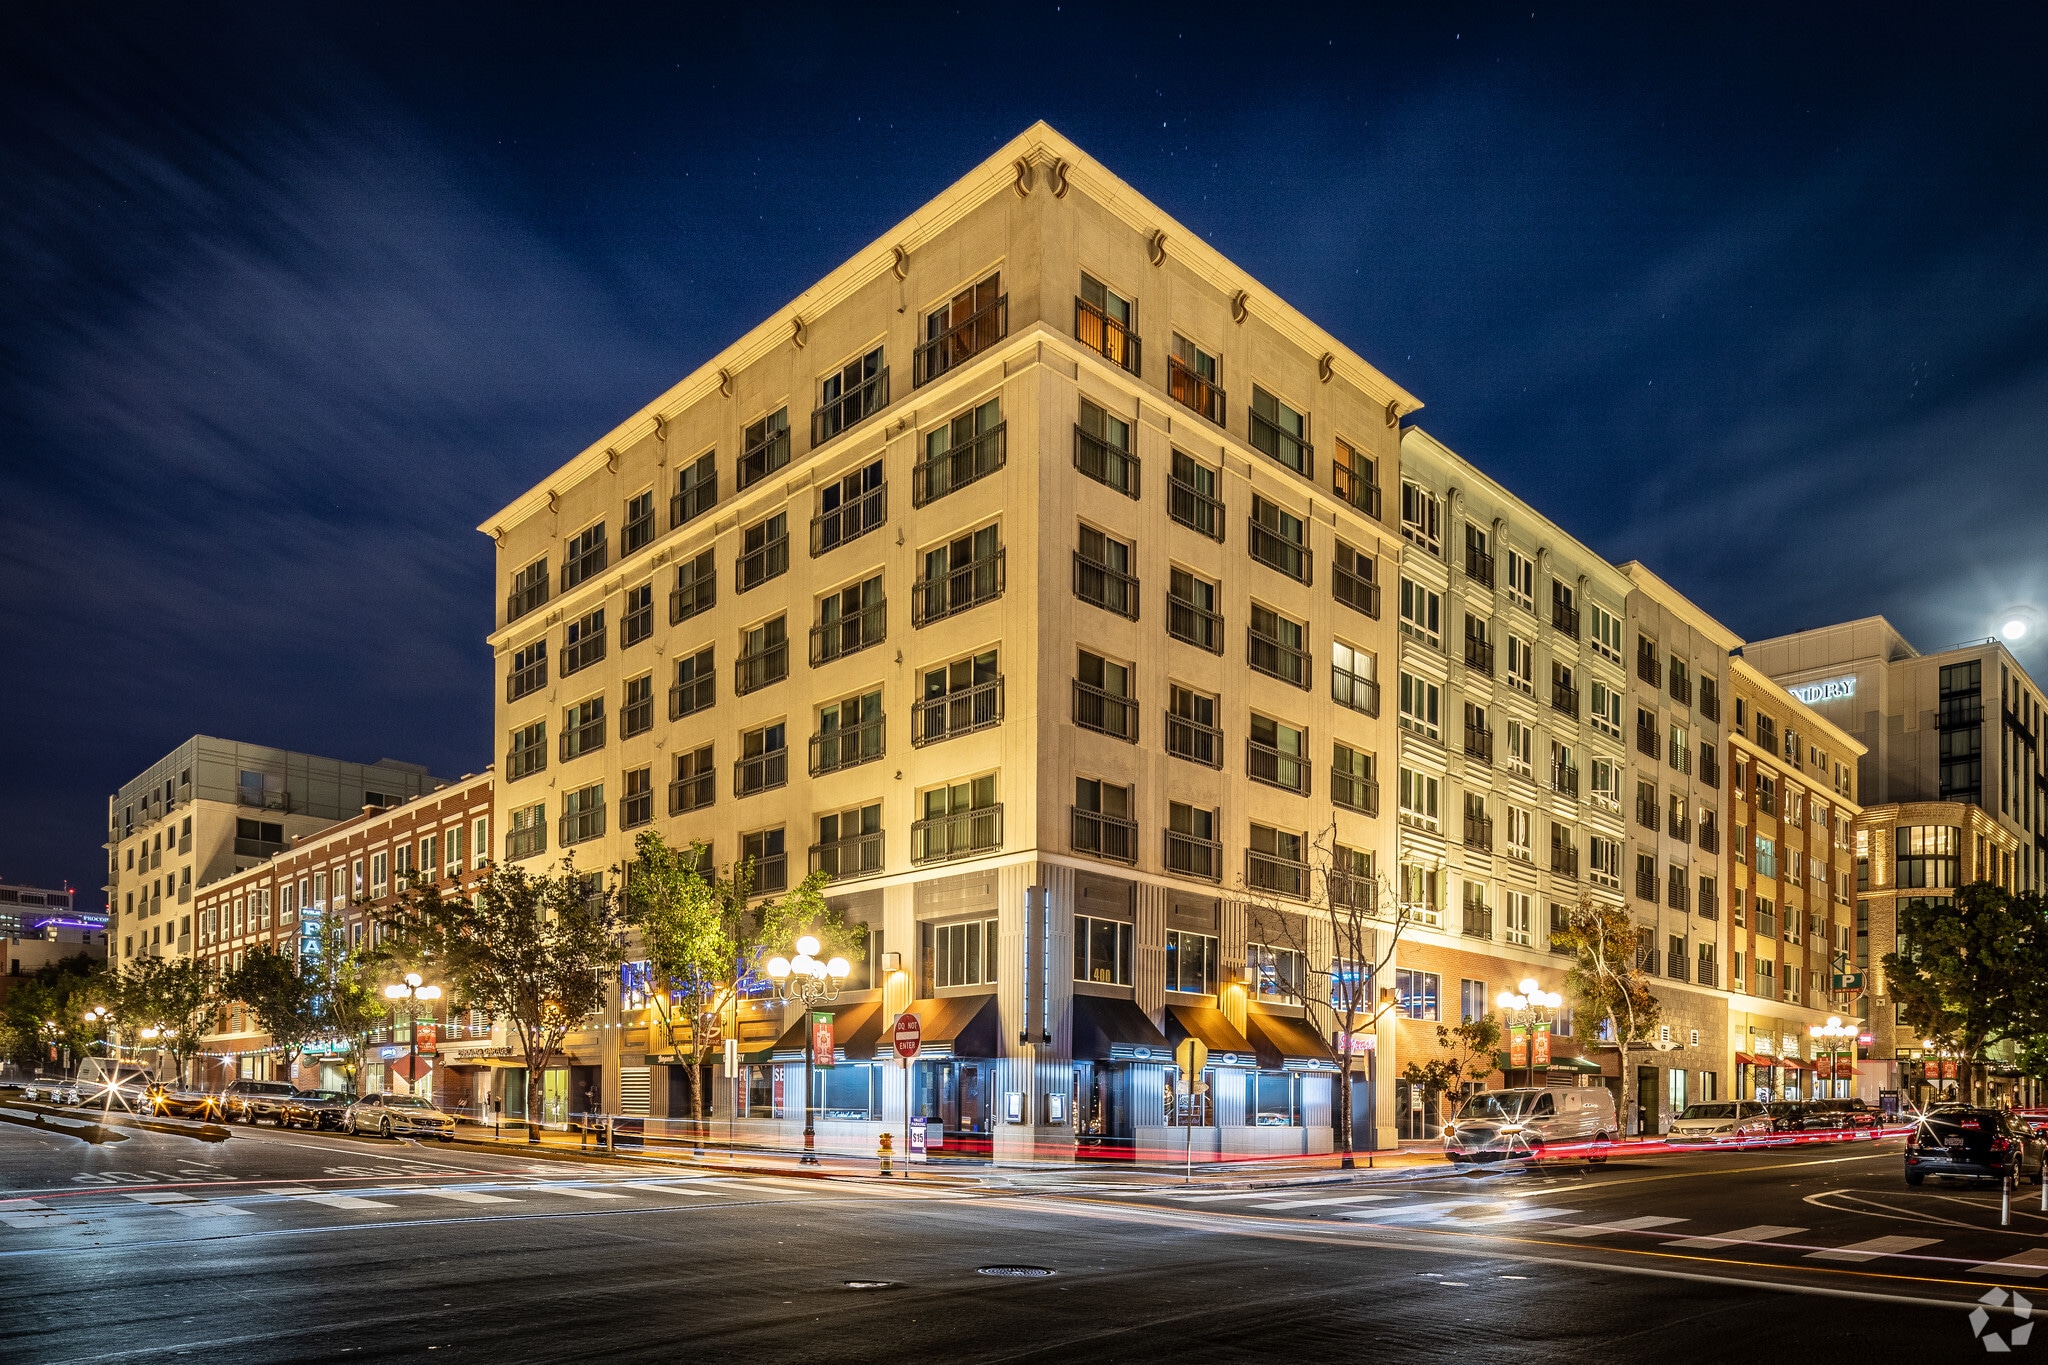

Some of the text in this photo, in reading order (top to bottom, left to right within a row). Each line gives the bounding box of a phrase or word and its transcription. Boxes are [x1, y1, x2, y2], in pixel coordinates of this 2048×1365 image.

[1094, 968, 1110, 982] 400
[1842, 975, 1855, 988] P
[898, 1021, 917, 1030] DO NOT
[900, 1041, 915, 1050] ENTER
[912, 1132, 924, 1143] $15
[71, 1169, 238, 1184] STOP
